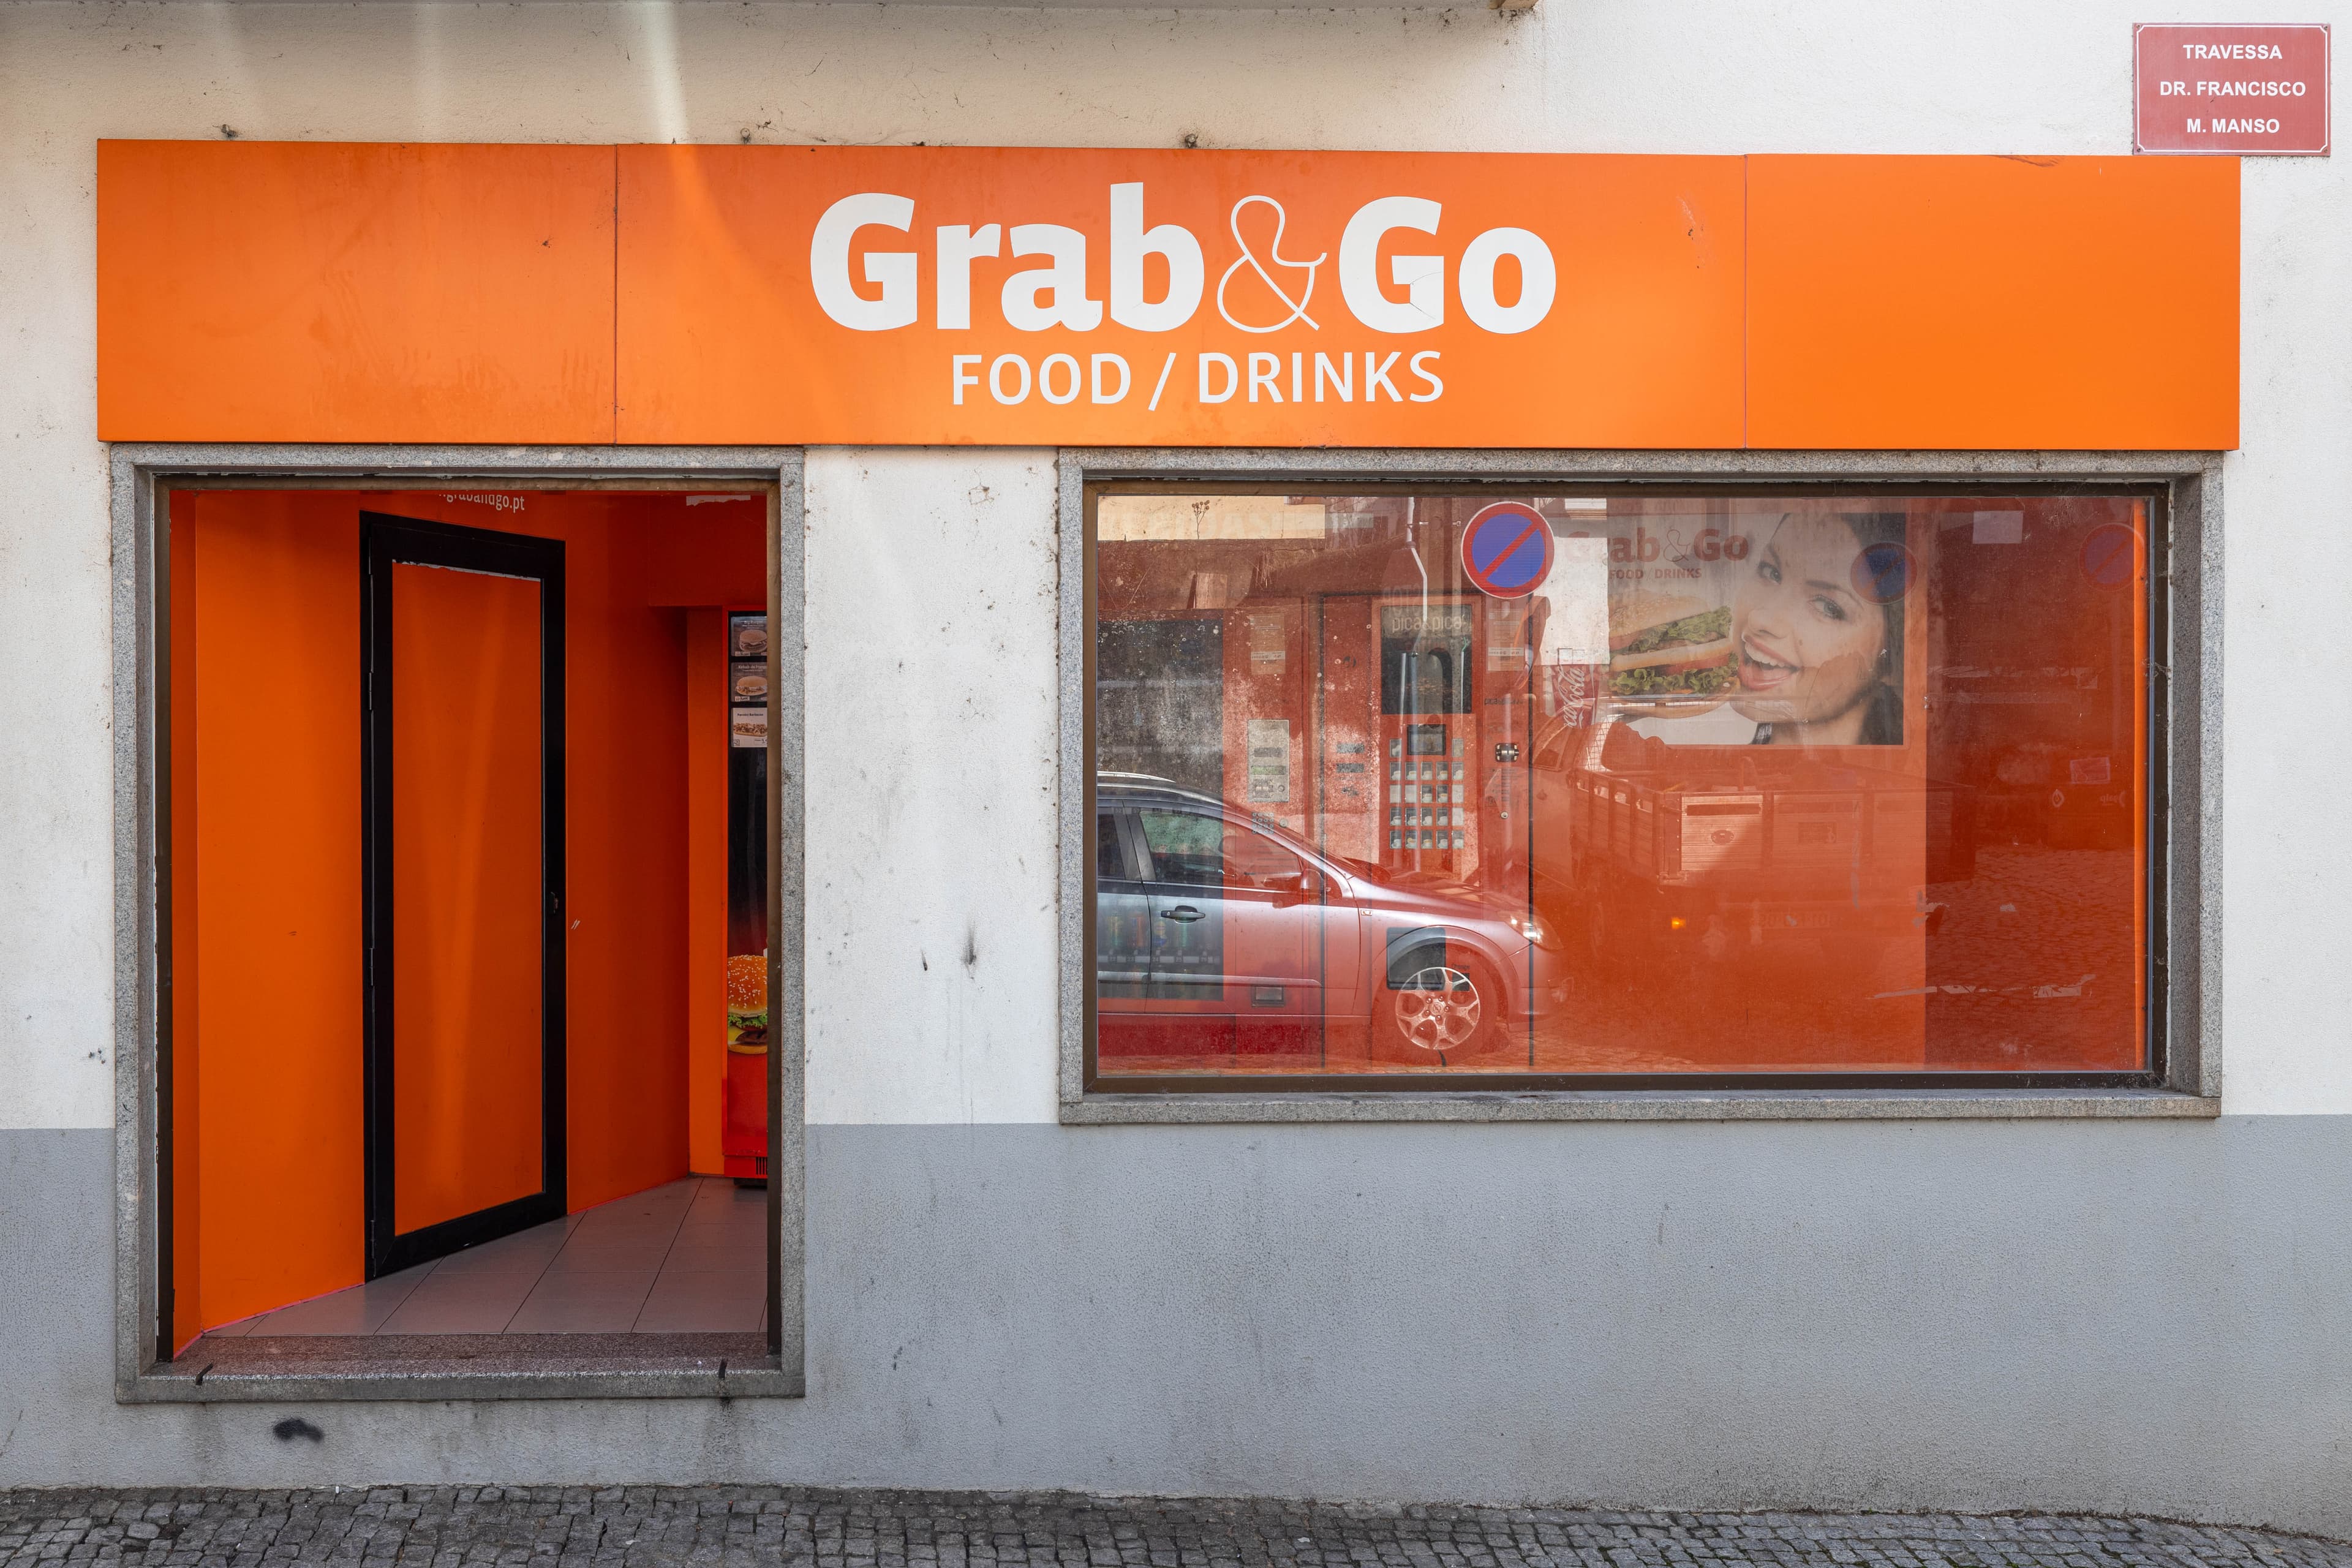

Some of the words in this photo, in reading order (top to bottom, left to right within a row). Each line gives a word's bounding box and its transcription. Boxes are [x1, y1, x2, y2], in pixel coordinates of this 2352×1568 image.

[2183, 45, 2283, 59] TRAVESSA
[2160, 81, 2191, 96] DR.
[2196, 81, 2306, 96] FRANCISCO
[2187, 118, 2206, 133] M.
[2212, 118, 2280, 134] MANSO
[810, 181, 1557, 334] Grab&Go
[952, 353, 1131, 405] FOOD
[1148, 352, 1177, 412] /
[1199, 350, 1444, 404] DRINKS
[1568, 527, 1749, 563] ab&Go
[1654, 568, 1702, 579] DRINKS
